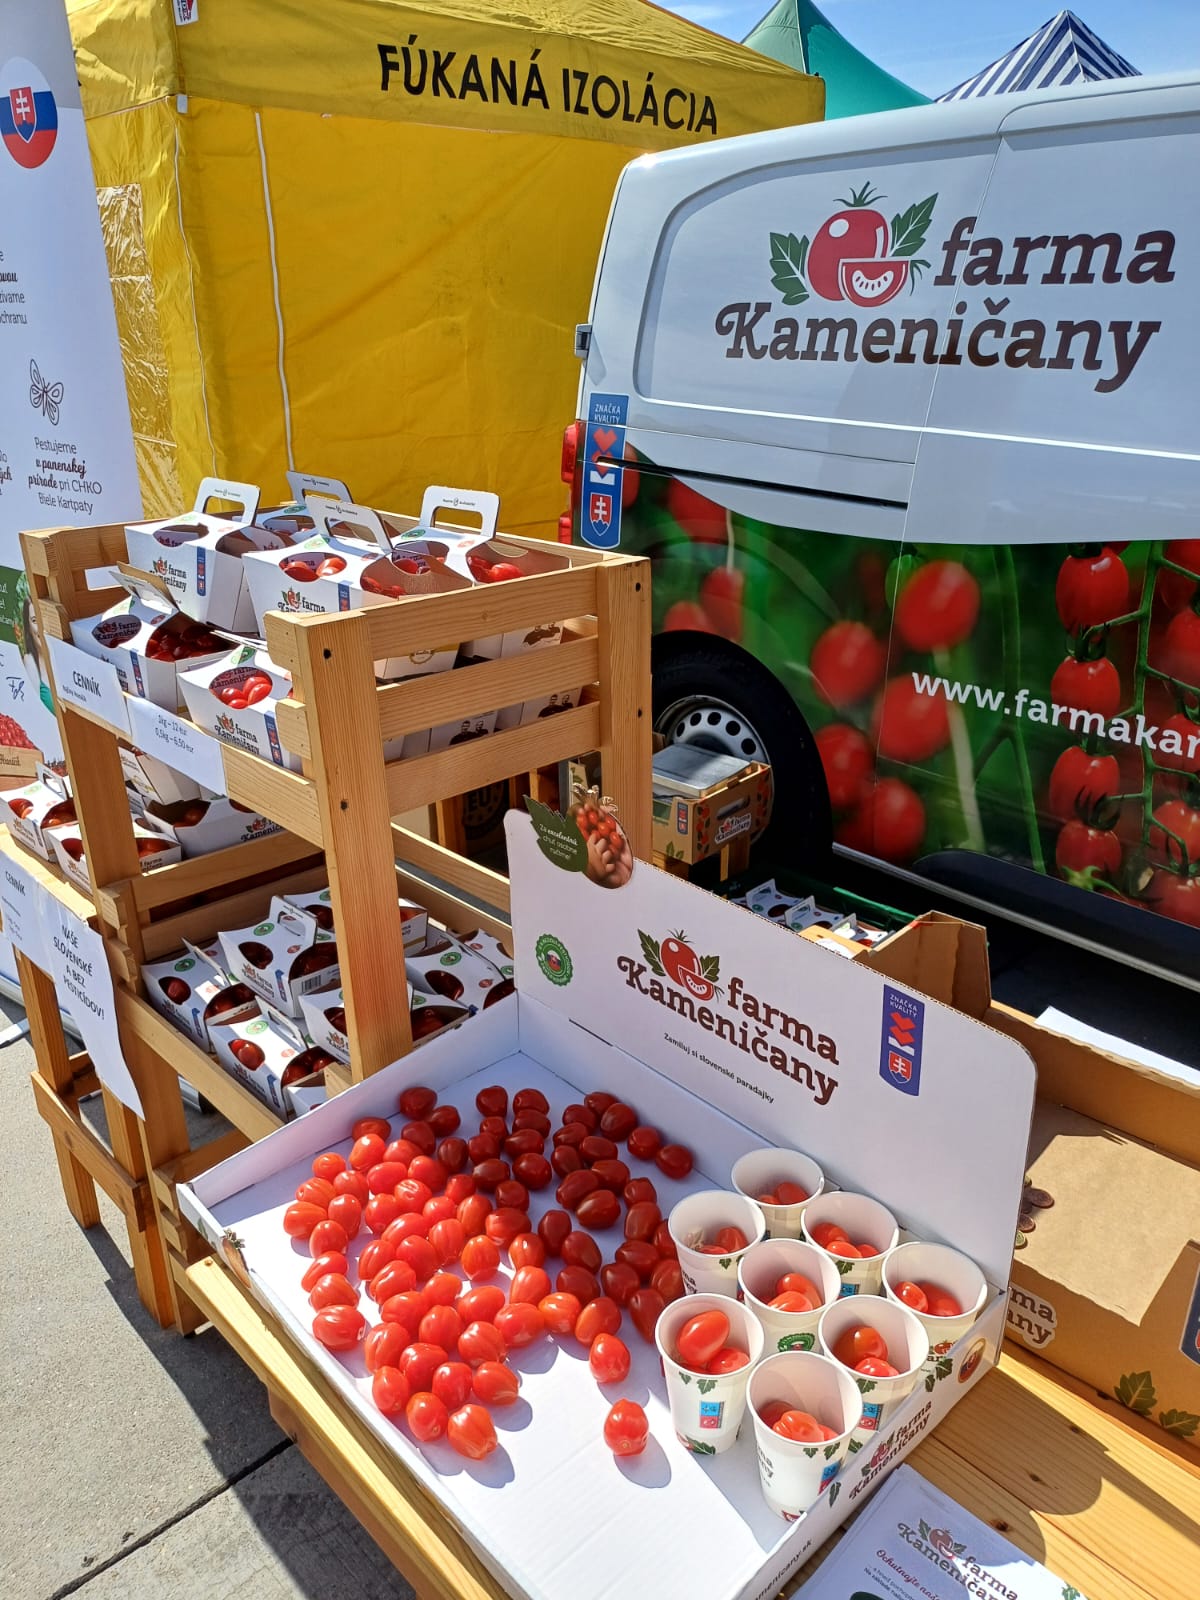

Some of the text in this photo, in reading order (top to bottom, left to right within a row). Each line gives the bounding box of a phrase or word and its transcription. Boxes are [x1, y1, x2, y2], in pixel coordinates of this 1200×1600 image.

[378, 35, 717, 135] FÚKANÁ IZOLÁCIA
[933, 216, 1176, 286] farma
[715, 297, 1162, 393] Kameničany
[594, 403, 621, 414] ZNAČKA
[594, 414, 620, 425] KVALITY
[34, 436, 77, 455] Pestujeme
[42, 458, 87, 480] panenskej
[59, 478, 70, 495] pri
[71, 480, 103, 495] CHKO
[168, 564, 187, 579] farma
[73, 670, 101, 697] CENNÍK
[61, 924, 79, 949] NAŠE
[53, 936, 93, 977] SLOVENSKÉ
[72, 969, 87, 989] BEZ
[889, 994, 918, 1012] ZNAČKA
[889, 1001, 918, 1018] KVALITY
[616, 955, 839, 1105] Kameničany
[727, 977, 840, 1066] farma
[664, 1032, 775, 1104] Zamiluj si slovenské paradajky
[895, 1401, 932, 1443] farma
[848, 1413, 931, 1500] Kameničany
[962, 1556, 1019, 1600] farma
